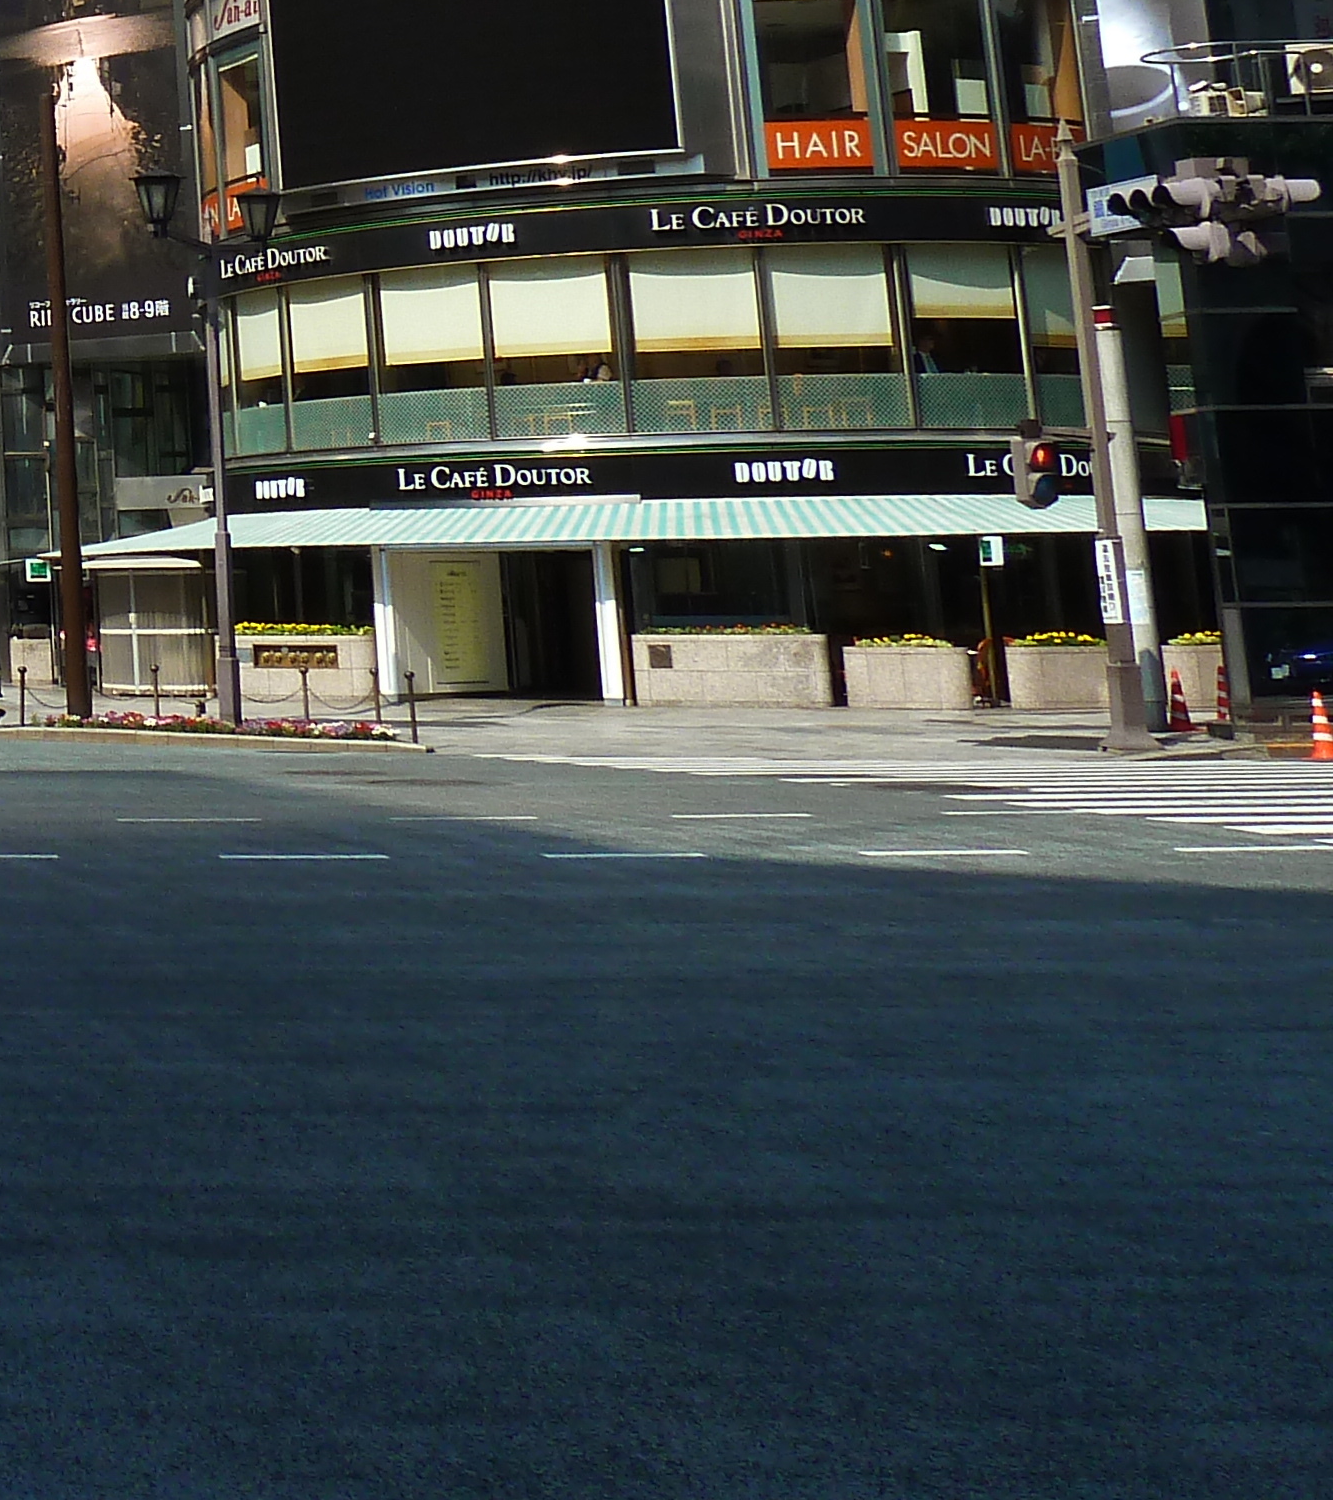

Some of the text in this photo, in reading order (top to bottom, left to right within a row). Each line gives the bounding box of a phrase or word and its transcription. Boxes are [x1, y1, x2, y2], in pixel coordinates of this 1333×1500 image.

[775, 129, 862, 163] HAIR
[902, 128, 992, 162] SALON
[392, 180, 435, 197] Vision
[737, 228, 784, 239] GINZA
[72, 303, 116, 324] CUBE
[734, 458, 835, 483] DOUTOR
